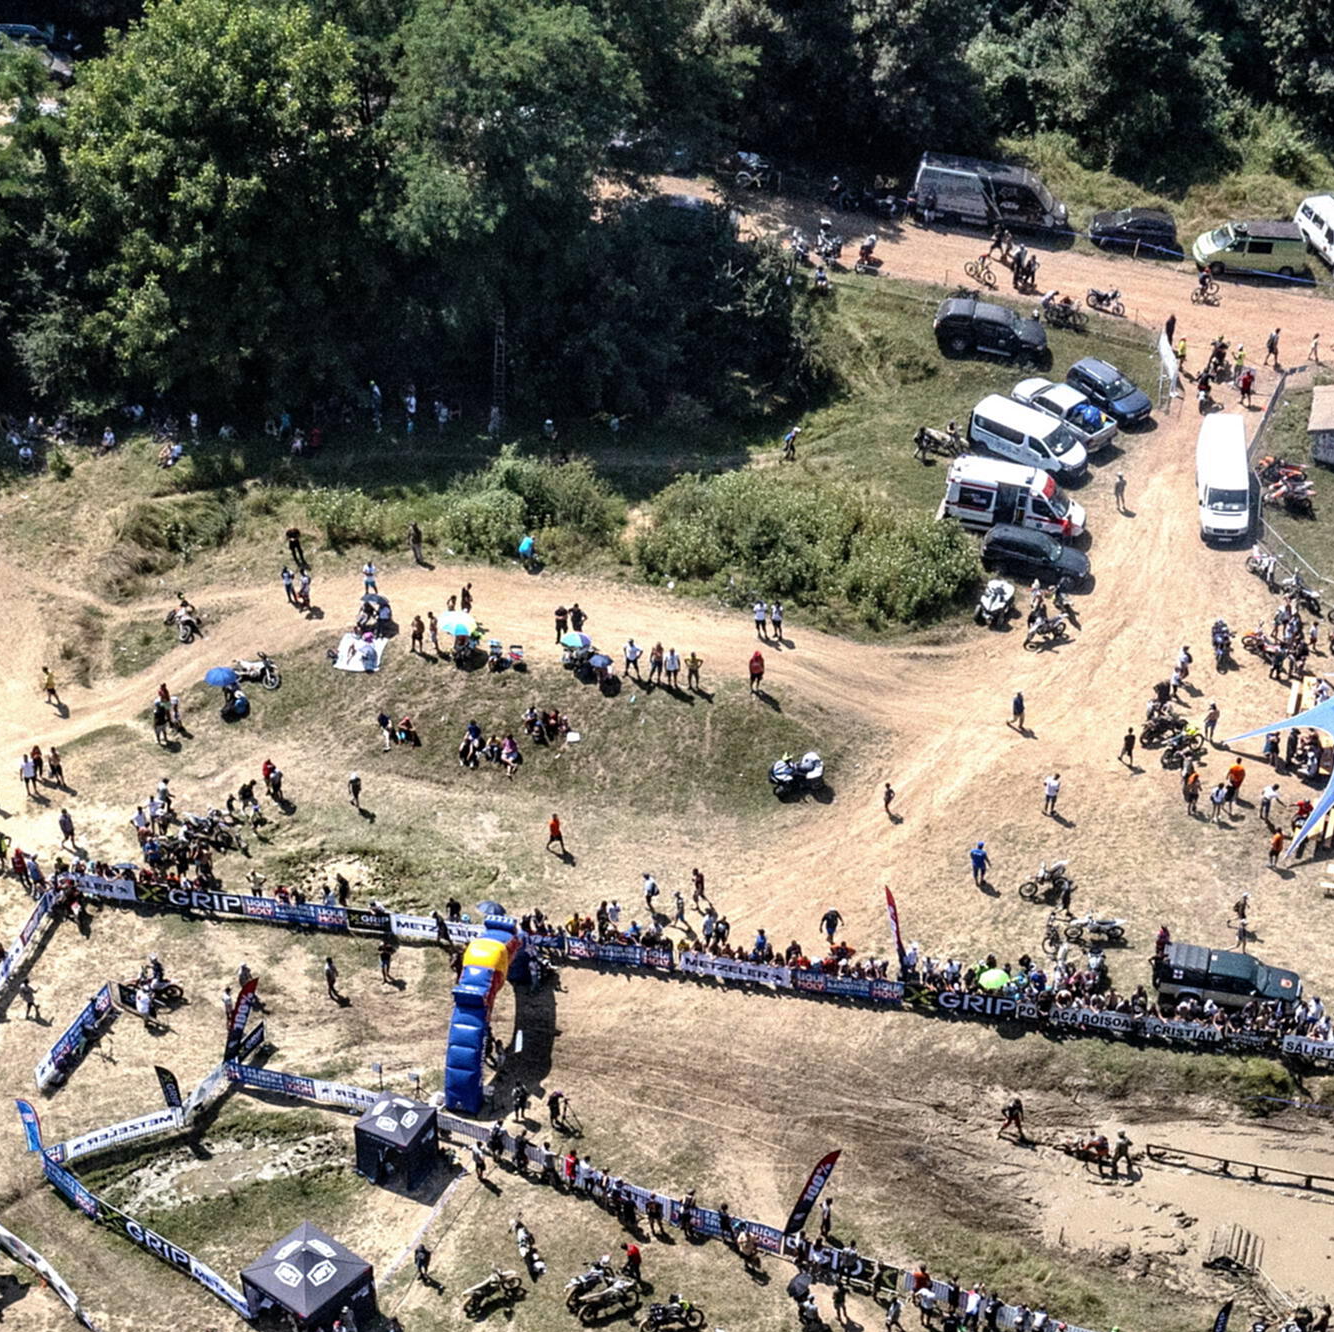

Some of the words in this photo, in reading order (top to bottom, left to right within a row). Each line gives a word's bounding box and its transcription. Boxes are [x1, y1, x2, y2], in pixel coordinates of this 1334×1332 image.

[168, 889, 242, 913] GRIP
[396, 920, 481, 939] METZLER
[685, 958, 769, 980] METZELER
[939, 991, 1016, 1016] GRIP
[1153, 1024, 1217, 1041] CRISTIAN
[803, 1163, 832, 1202] 100%
[125, 1220, 189, 1265] GRIP
